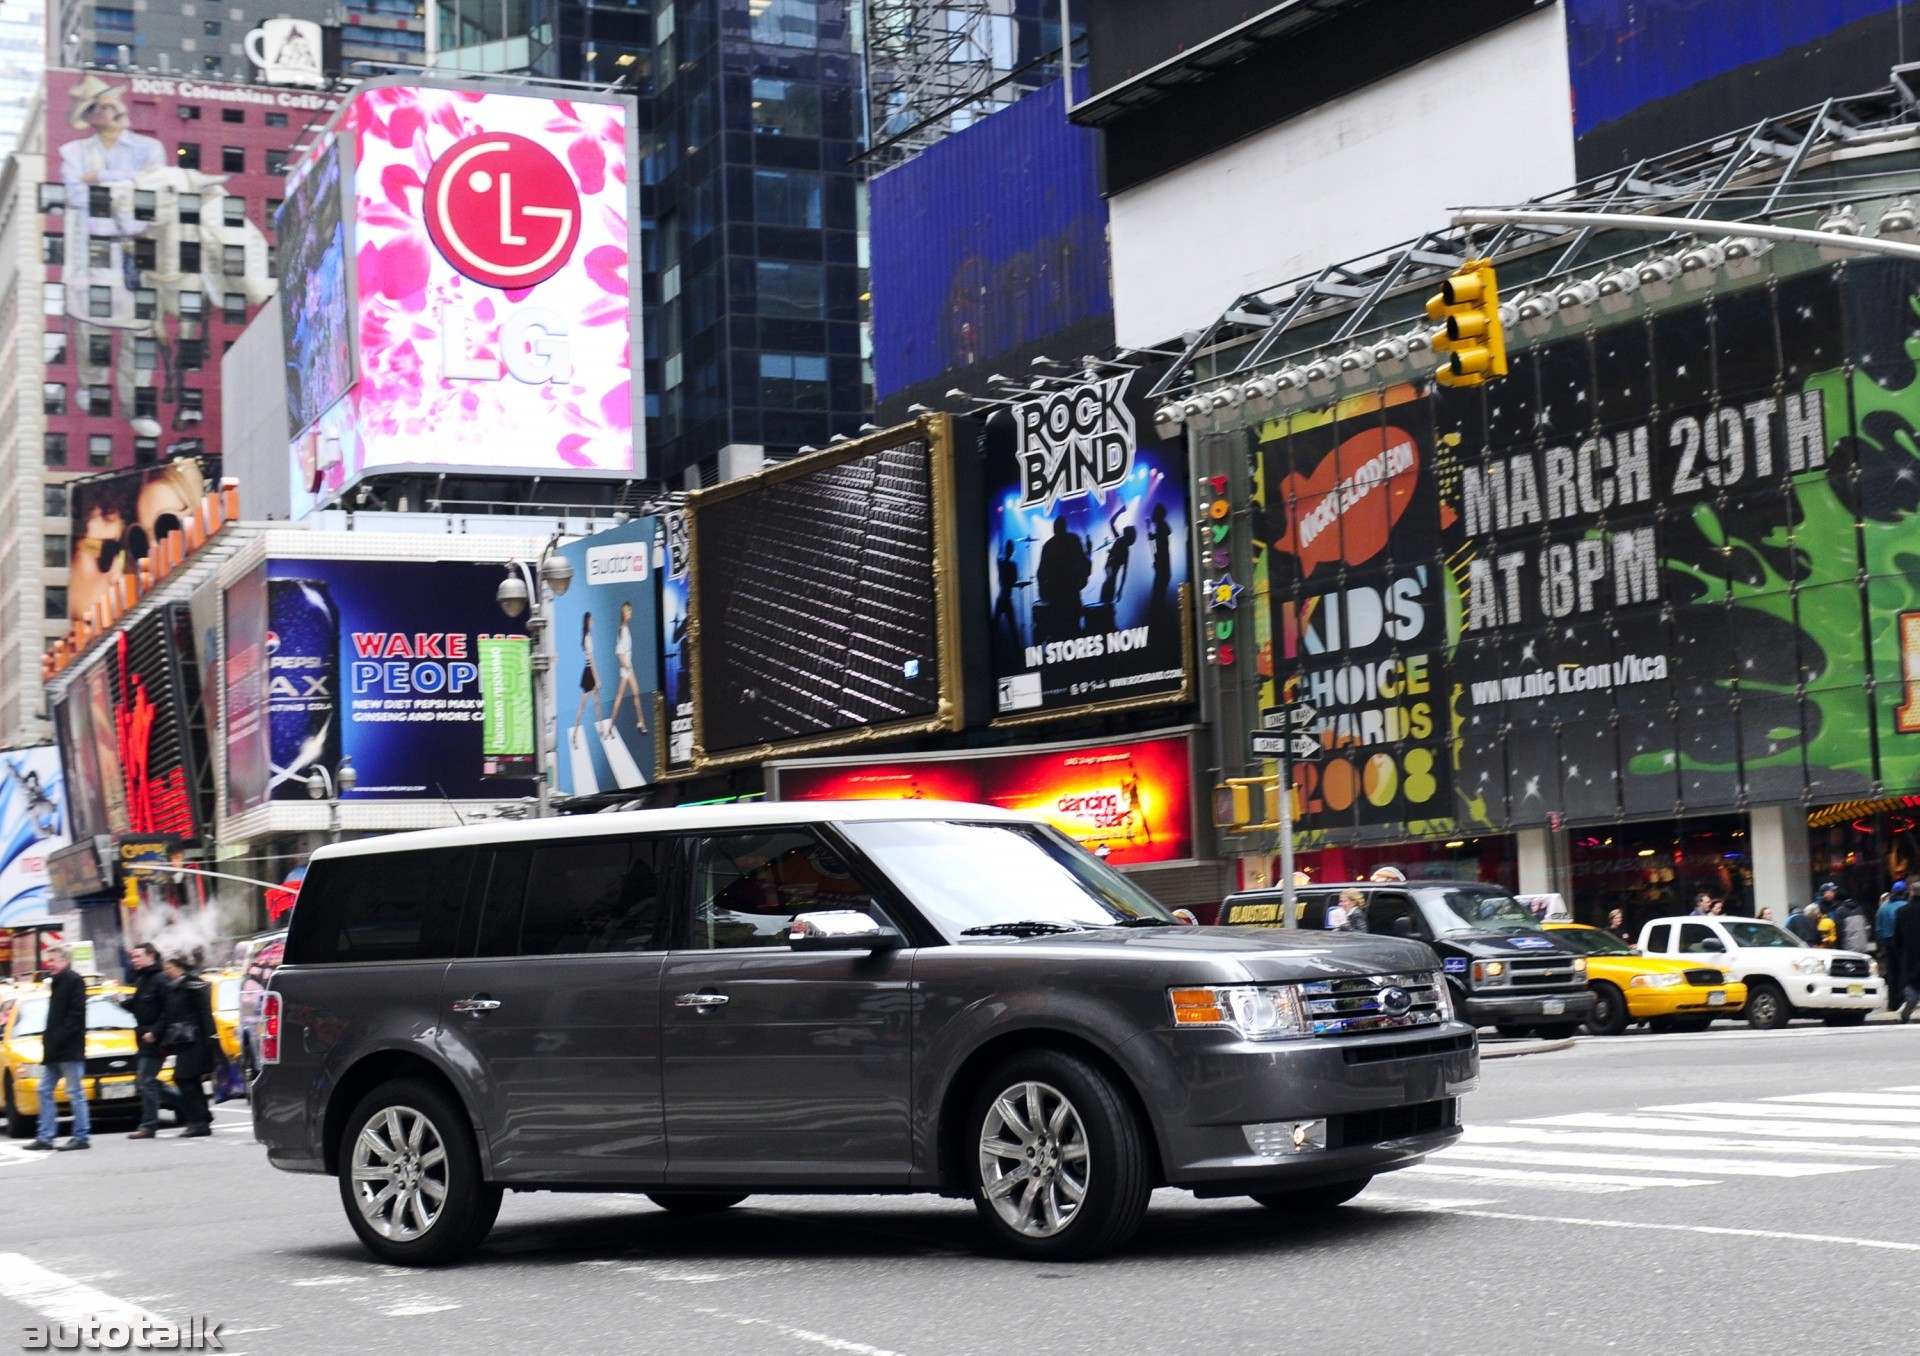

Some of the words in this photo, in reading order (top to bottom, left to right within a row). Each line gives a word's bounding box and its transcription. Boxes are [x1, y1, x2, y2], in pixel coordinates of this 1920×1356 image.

[178, 82, 275, 105] Colombian
[442, 306, 571, 386] LG
[1011, 370, 1137, 457] ROCK
[1015, 428, 1136, 517] BAND
[1463, 426, 1652, 538] MARCH
[1668, 388, 1826, 496] 29TH
[1299, 441, 1414, 539] NICKELODEON
[1467, 550, 1525, 632] AT
[1538, 525, 1660, 619] 8PM
[1282, 564, 1430, 660] KIDS'
[270, 656, 323, 669] PEPSI
[351, 632, 468, 659] WAKE
[1025, 645, 1044, 668] IN
[1045, 634, 1104, 665] STORES
[1106, 625, 1150, 654] NOW
[351, 661, 485, 694] PEOP
[1283, 653, 1431, 709] CHOICE
[351, 700, 383, 710] NEW
[384, 700, 413, 710] DIET
[414, 700, 447, 710] PEPSI
[352, 712, 407, 721] GINSENG
[407, 712, 435, 721] AND
[435, 711, 471, 721] MORE
[1269, 713, 1286, 726] ONE
[1260, 739, 1281, 750] ONE
[1292, 748, 1437, 815] 2008
[1058, 790, 1117, 817] dancing
[1095, 811, 1134, 829] stars
